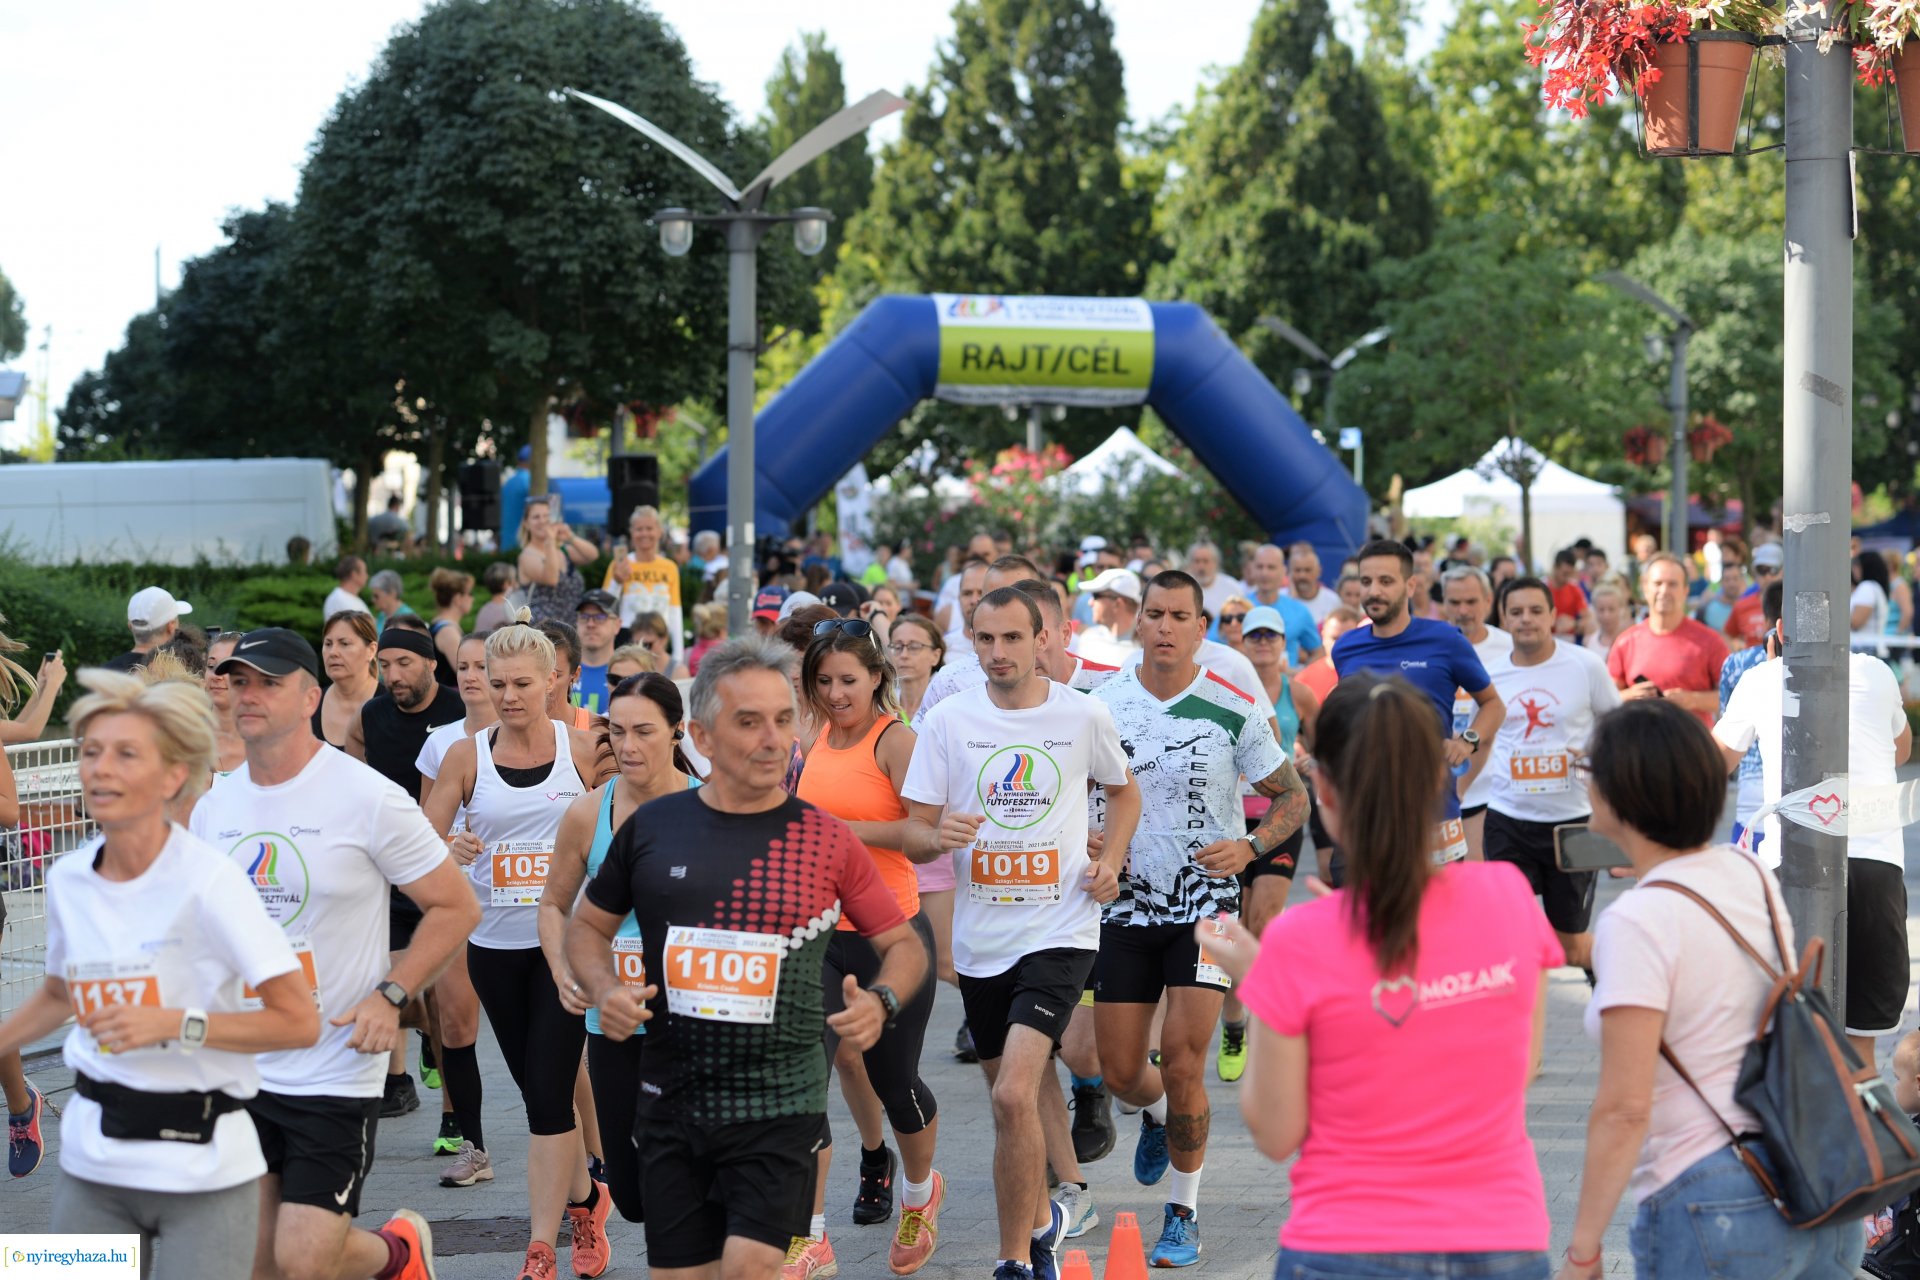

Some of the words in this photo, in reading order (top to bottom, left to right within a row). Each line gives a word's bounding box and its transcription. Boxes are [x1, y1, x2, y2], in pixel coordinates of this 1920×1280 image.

[962, 338, 1130, 376] RAJT/CÉL
[1513, 755, 1563, 775] 1156
[986, 797, 1051, 806] FUTÓFESZTIVÁL
[499, 855, 550, 878] 105
[977, 853, 1050, 876] 1019
[613, 953, 645, 977] 10
[676, 949, 768, 984] 1106
[1420, 962, 1515, 1003] MOZAIK
[73, 980, 147, 1016] 1137
[1035, 1004, 1055, 1017] benger
